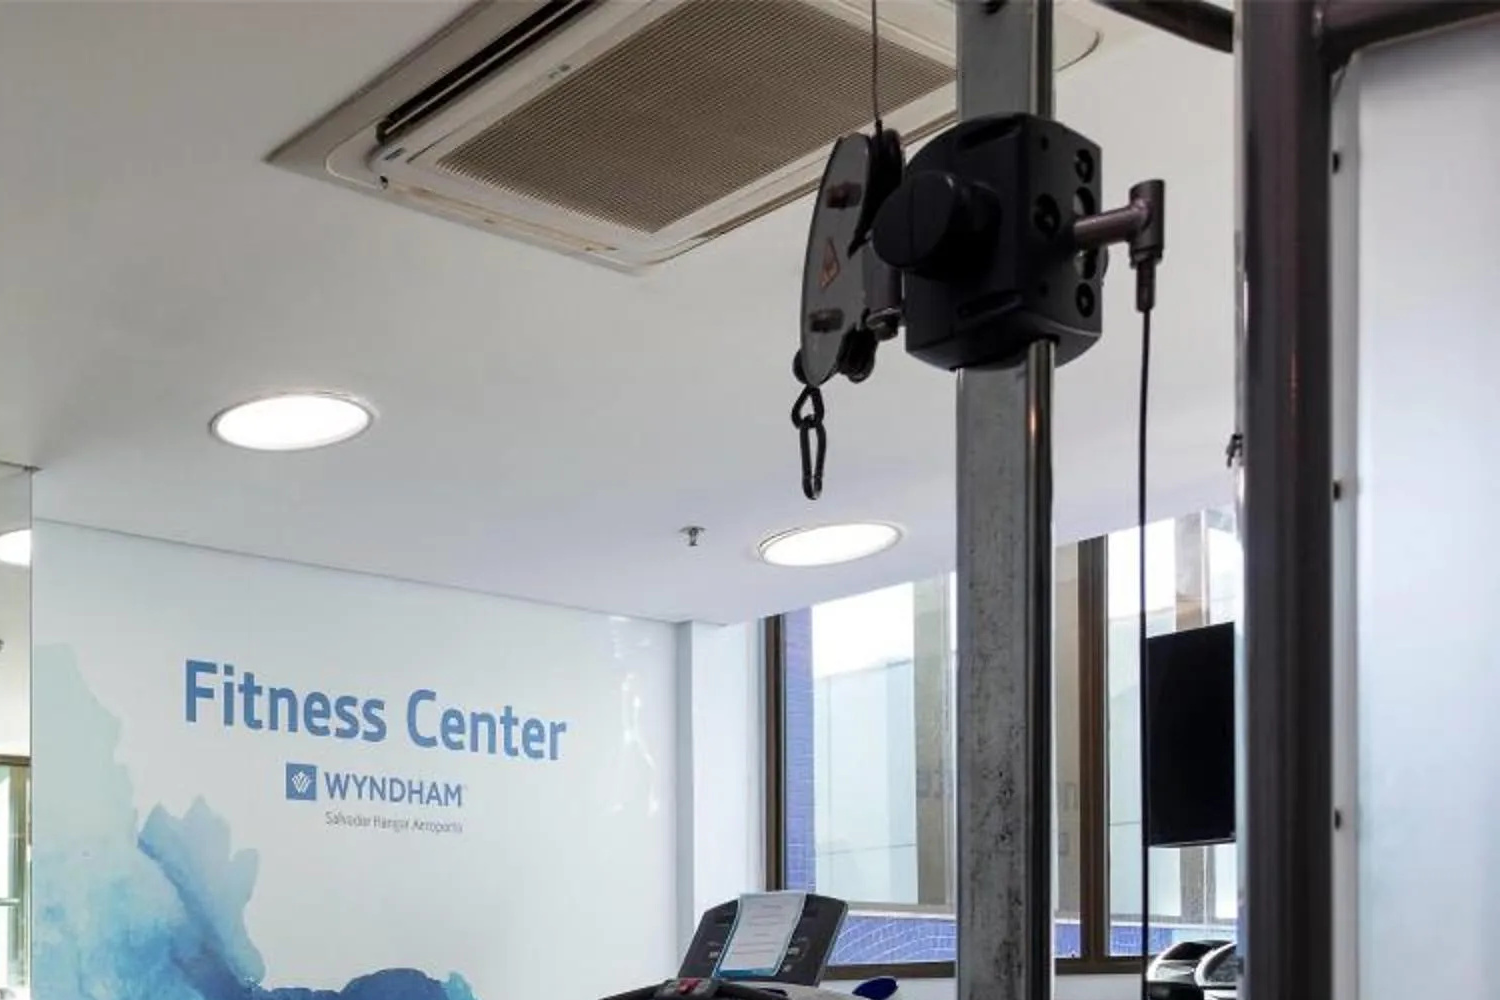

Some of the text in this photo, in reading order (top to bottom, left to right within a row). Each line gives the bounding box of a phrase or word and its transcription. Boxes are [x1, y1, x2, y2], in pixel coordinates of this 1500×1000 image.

[184, 658, 567, 761] Fitness Center
[323, 771, 463, 808] WYNDHAM
